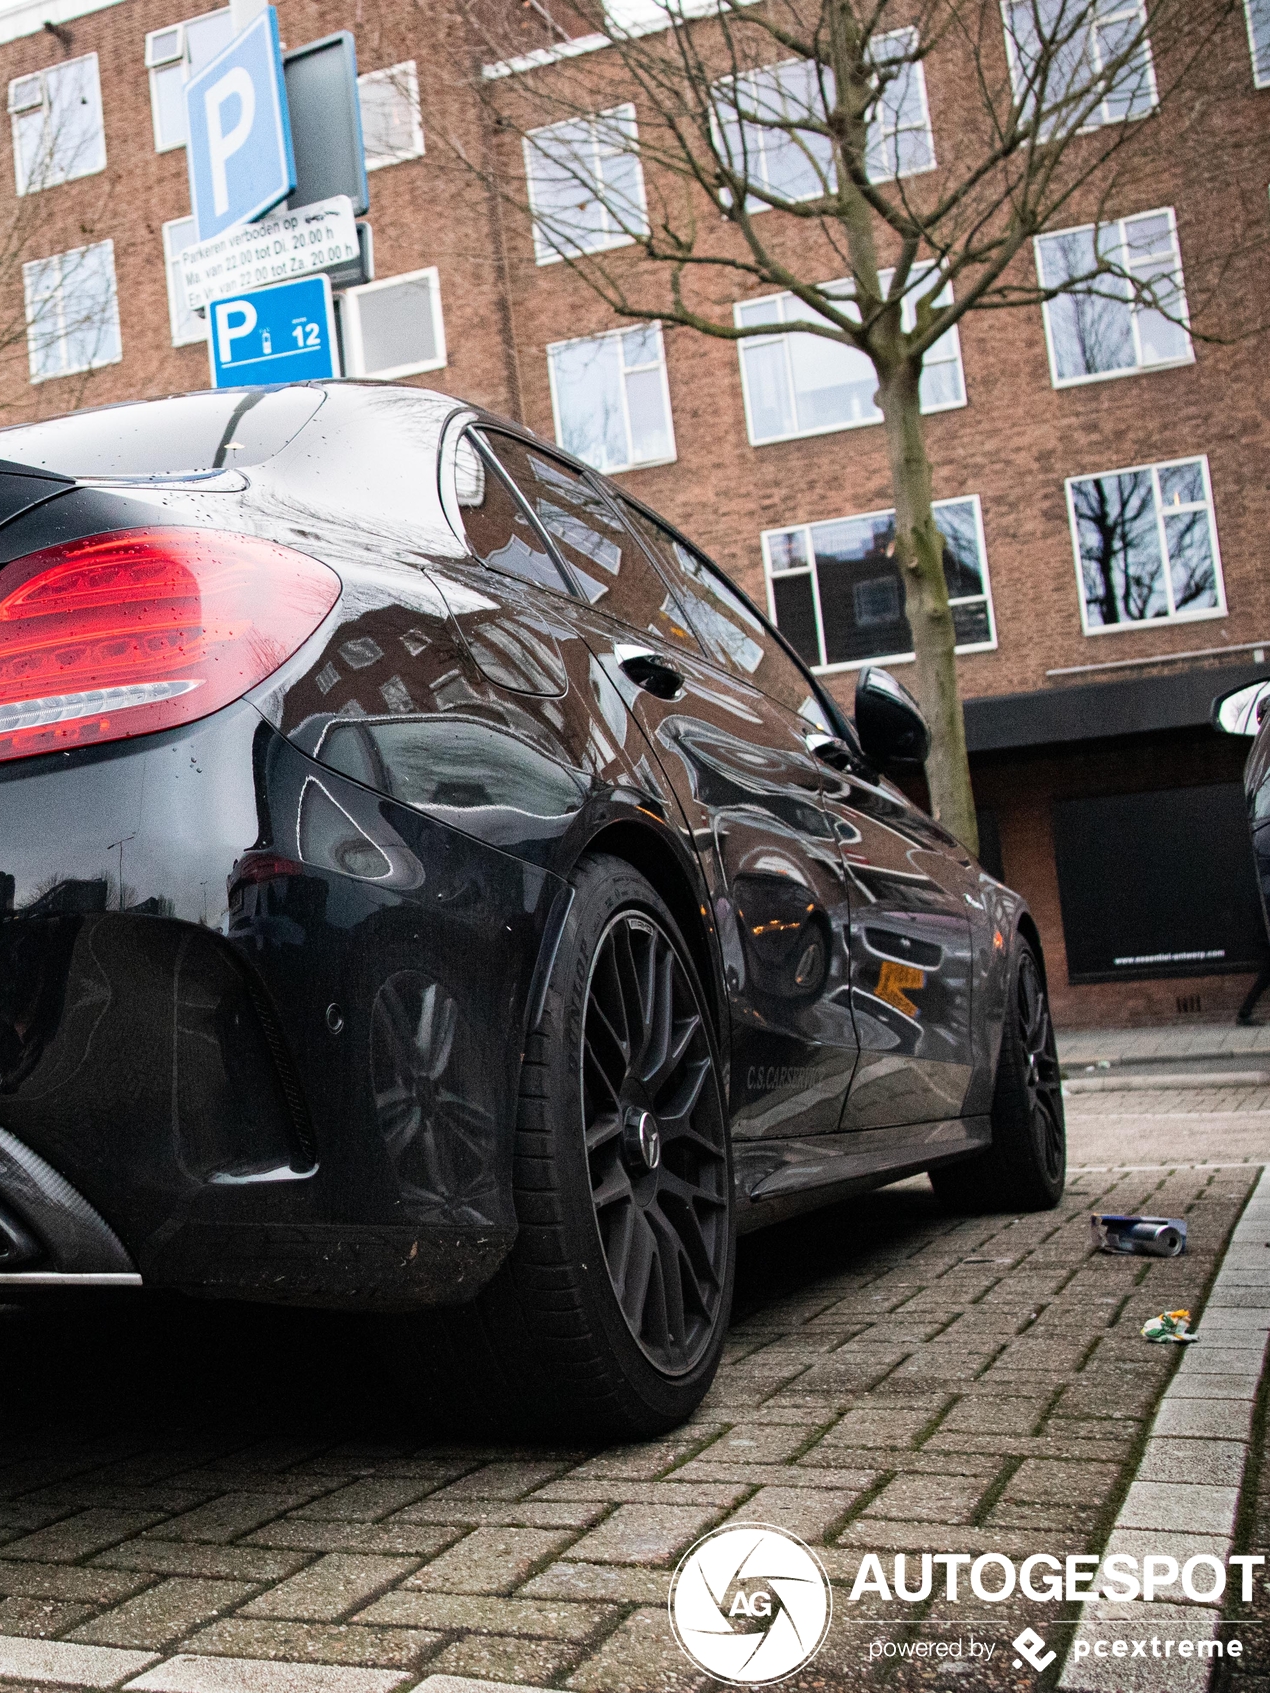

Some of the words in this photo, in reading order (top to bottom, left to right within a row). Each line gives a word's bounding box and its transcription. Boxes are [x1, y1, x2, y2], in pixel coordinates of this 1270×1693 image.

[204, 65, 256, 217] P
[183, 240, 227, 266] Parkeren
[229, 222, 280, 247] verboden
[283, 216, 299, 231] op
[185, 271, 202, 287] Ma.
[205, 262, 224, 278] van
[225, 252, 253, 272] 22.00
[255, 244, 271, 261] tot
[273, 239, 290, 256] Di.
[293, 230, 323, 250] 20.00
[326, 225, 335, 240] h
[188, 292, 202, 307] En
[219, 279, 237, 294] van
[240, 268, 268, 287] 22.00
[271, 262, 288, 277] tot
[290, 257, 309, 273] Za.
[311, 246, 342, 266] 20.00
[345, 243, 354, 257] h
[215, 300, 258, 363] P
[292, 322, 322, 348] 12
